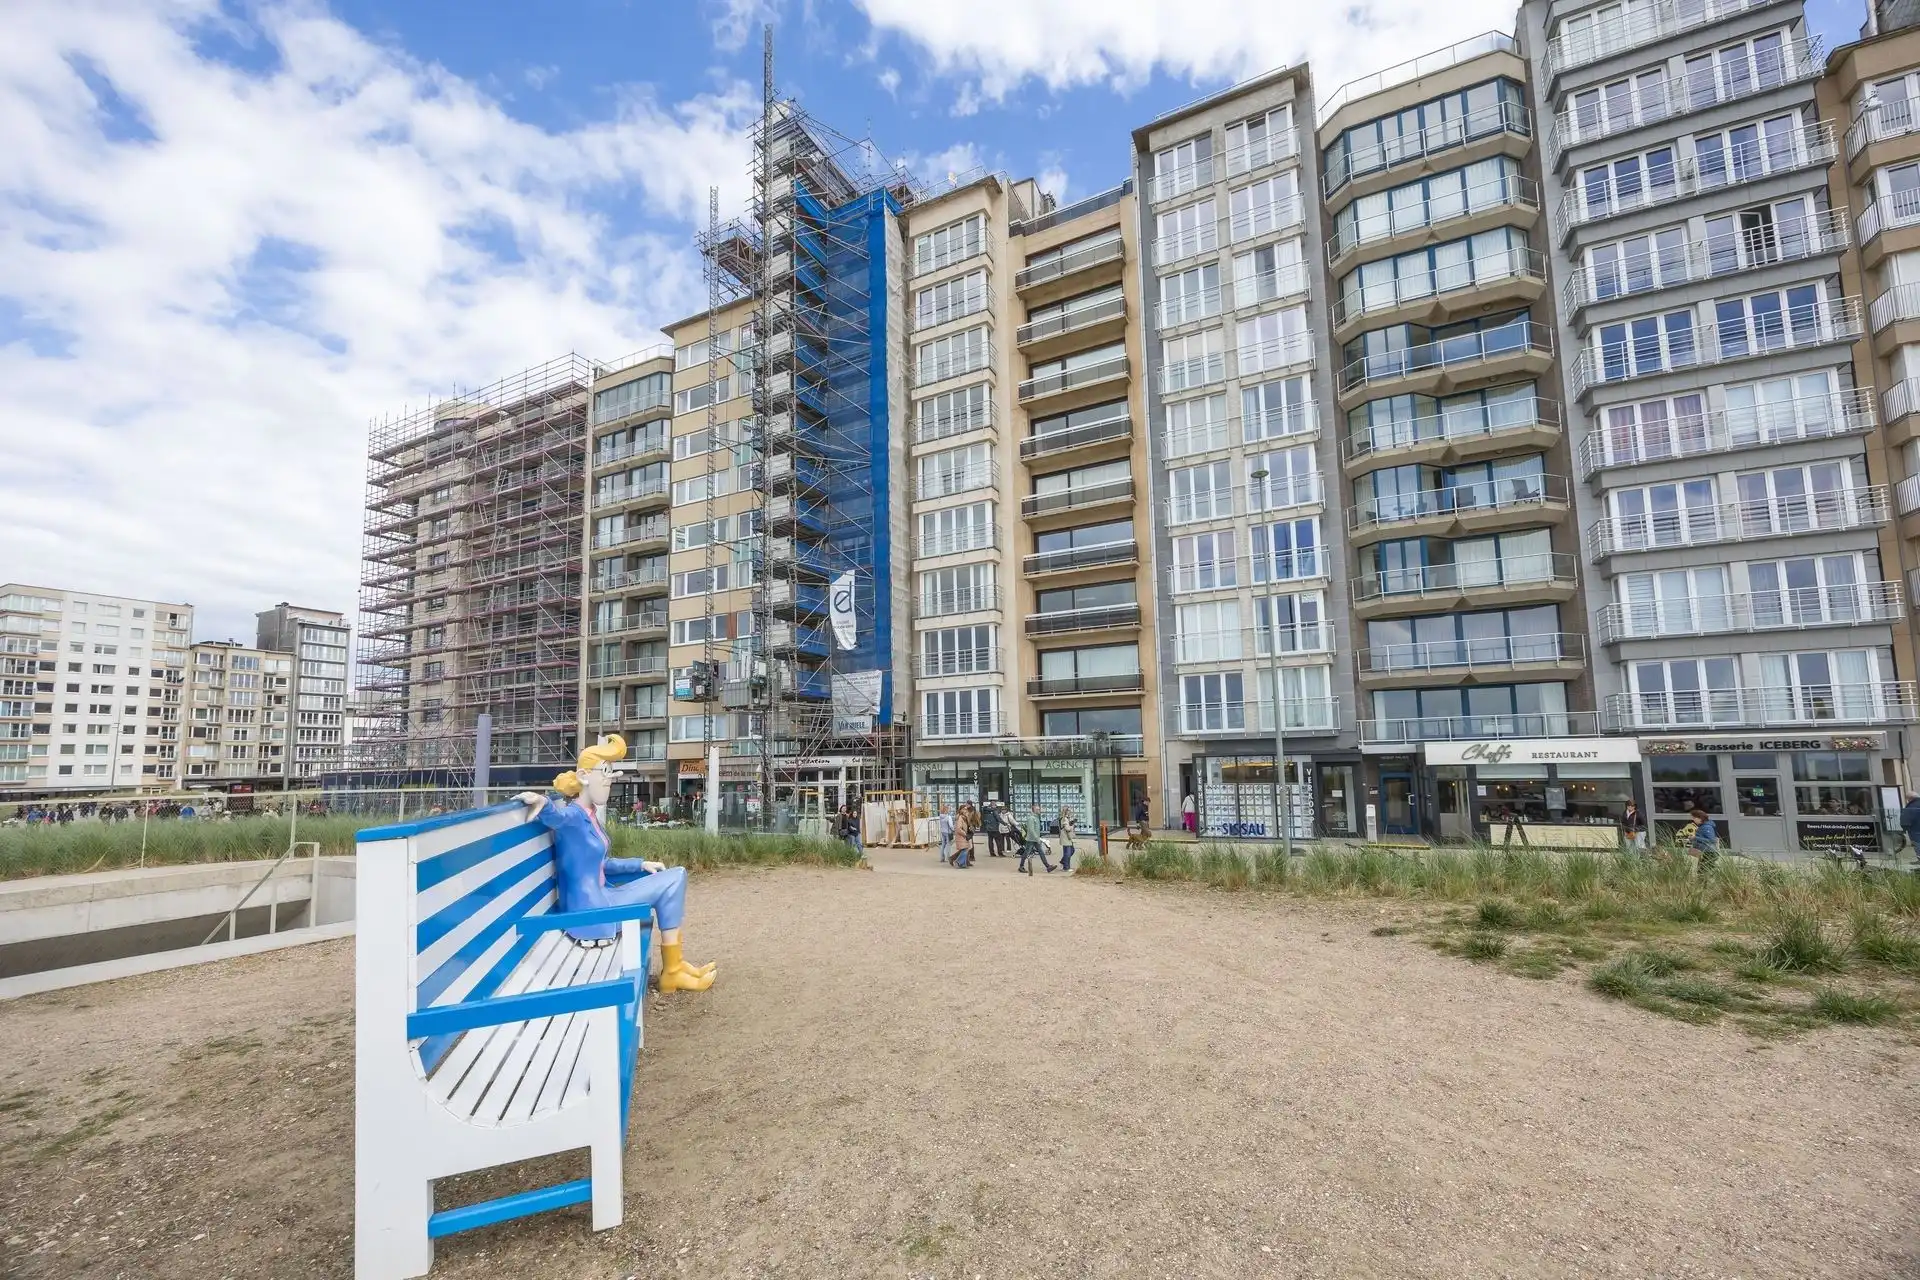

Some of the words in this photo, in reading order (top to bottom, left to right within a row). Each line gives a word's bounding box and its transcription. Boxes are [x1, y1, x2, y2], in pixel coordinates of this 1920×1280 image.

[1695, 742, 1753, 751] Brasserie
[1759, 740, 1822, 750] ICEBERG
[1531, 751, 1599, 759] RESTAURANT
[1045, 759, 1089, 769] AGENCE
[1222, 823, 1266, 836] SISSAU
